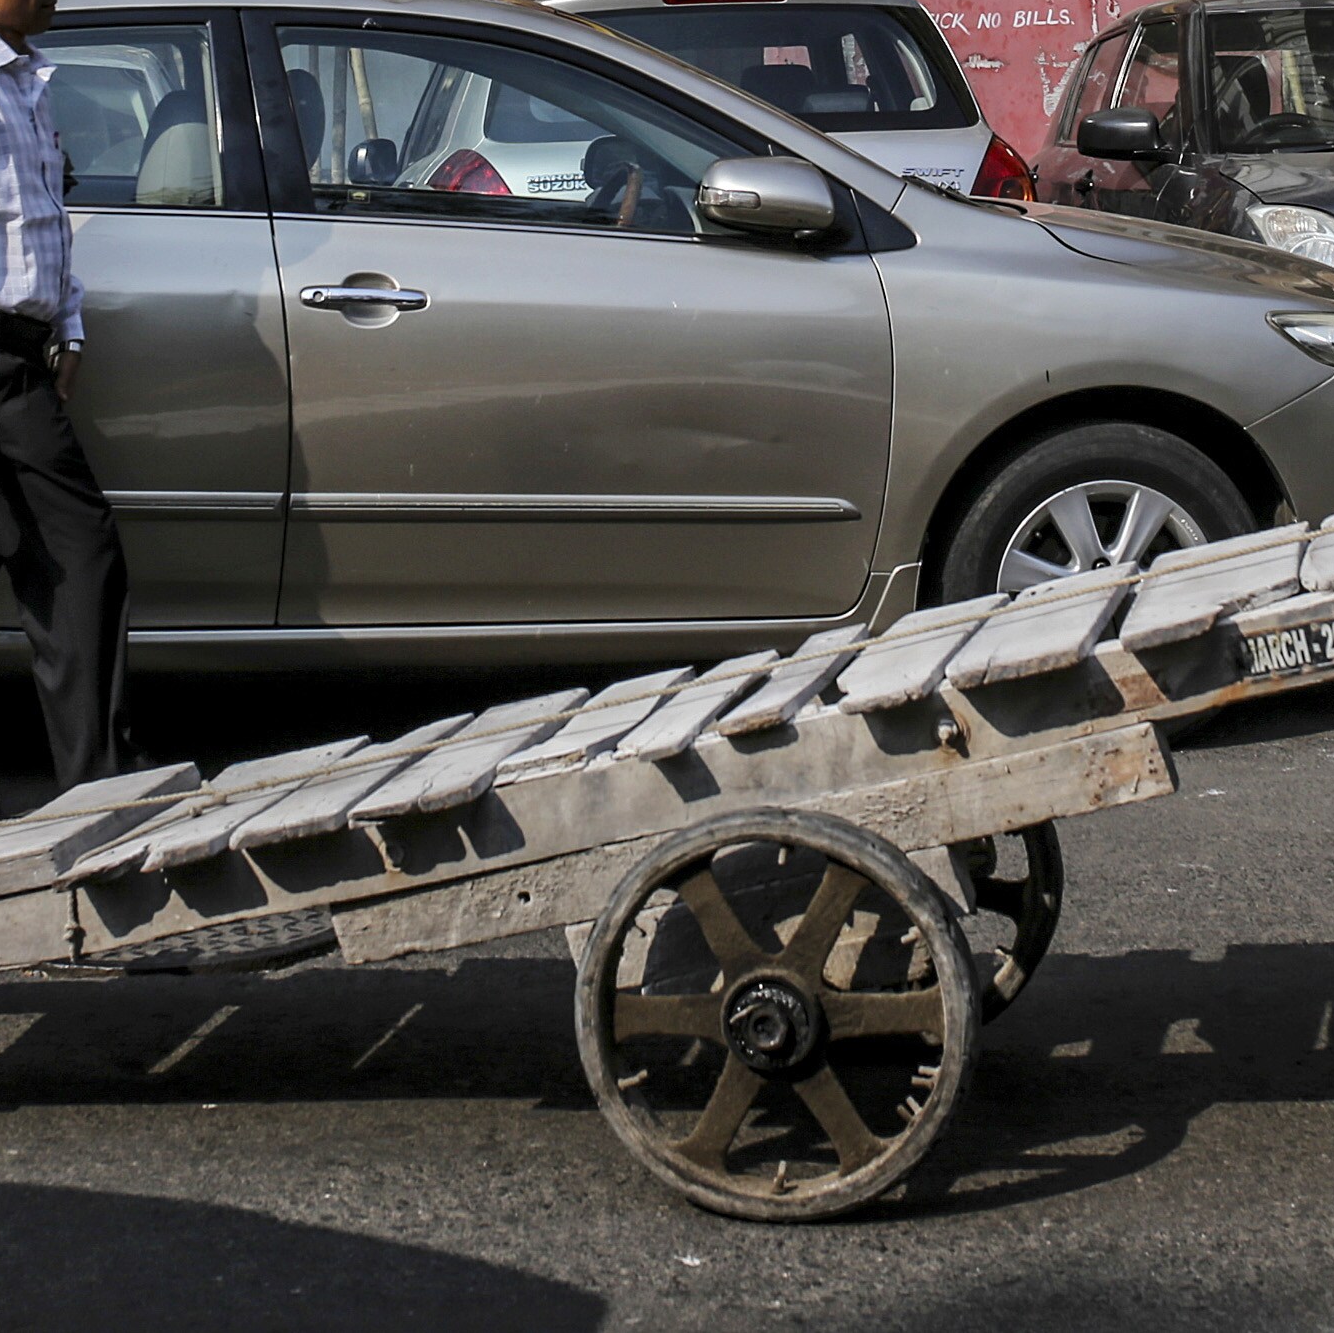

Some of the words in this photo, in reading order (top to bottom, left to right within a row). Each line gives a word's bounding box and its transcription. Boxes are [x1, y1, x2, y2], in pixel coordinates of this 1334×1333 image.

[977, 12, 1002, 30] NO
[1012, 9, 1075, 29] BILLS.
[902, 168, 965, 178] SWIFT
[527, 180, 586, 193] SUZUK
